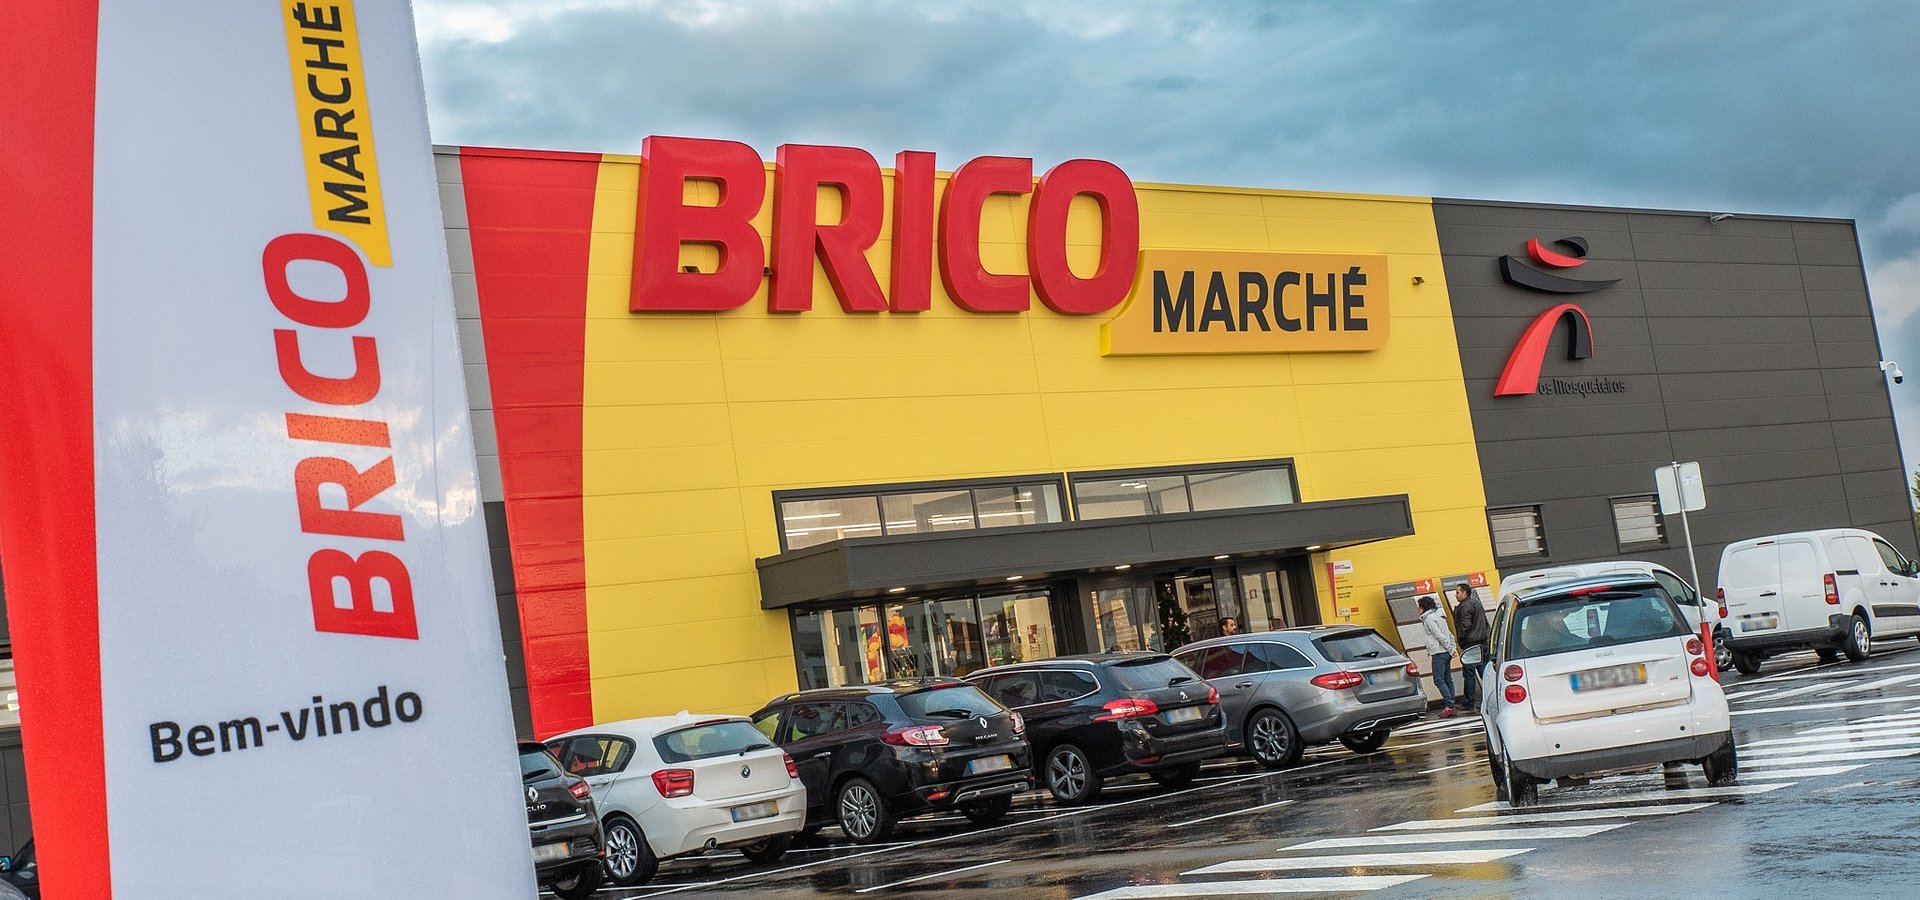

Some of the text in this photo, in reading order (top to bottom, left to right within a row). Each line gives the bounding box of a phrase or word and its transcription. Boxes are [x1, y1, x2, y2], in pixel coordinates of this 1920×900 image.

[292, 2, 371, 225] MARCHÉ
[630, 135, 1140, 314] BRICO
[1152, 266, 1368, 333] MARCHÉ
[1538, 382, 1552, 396] os
[263, 233, 419, 640] BRICO
[149, 686, 424, 763] Bem-vindo
[526, 804, 547, 812] CLIO
